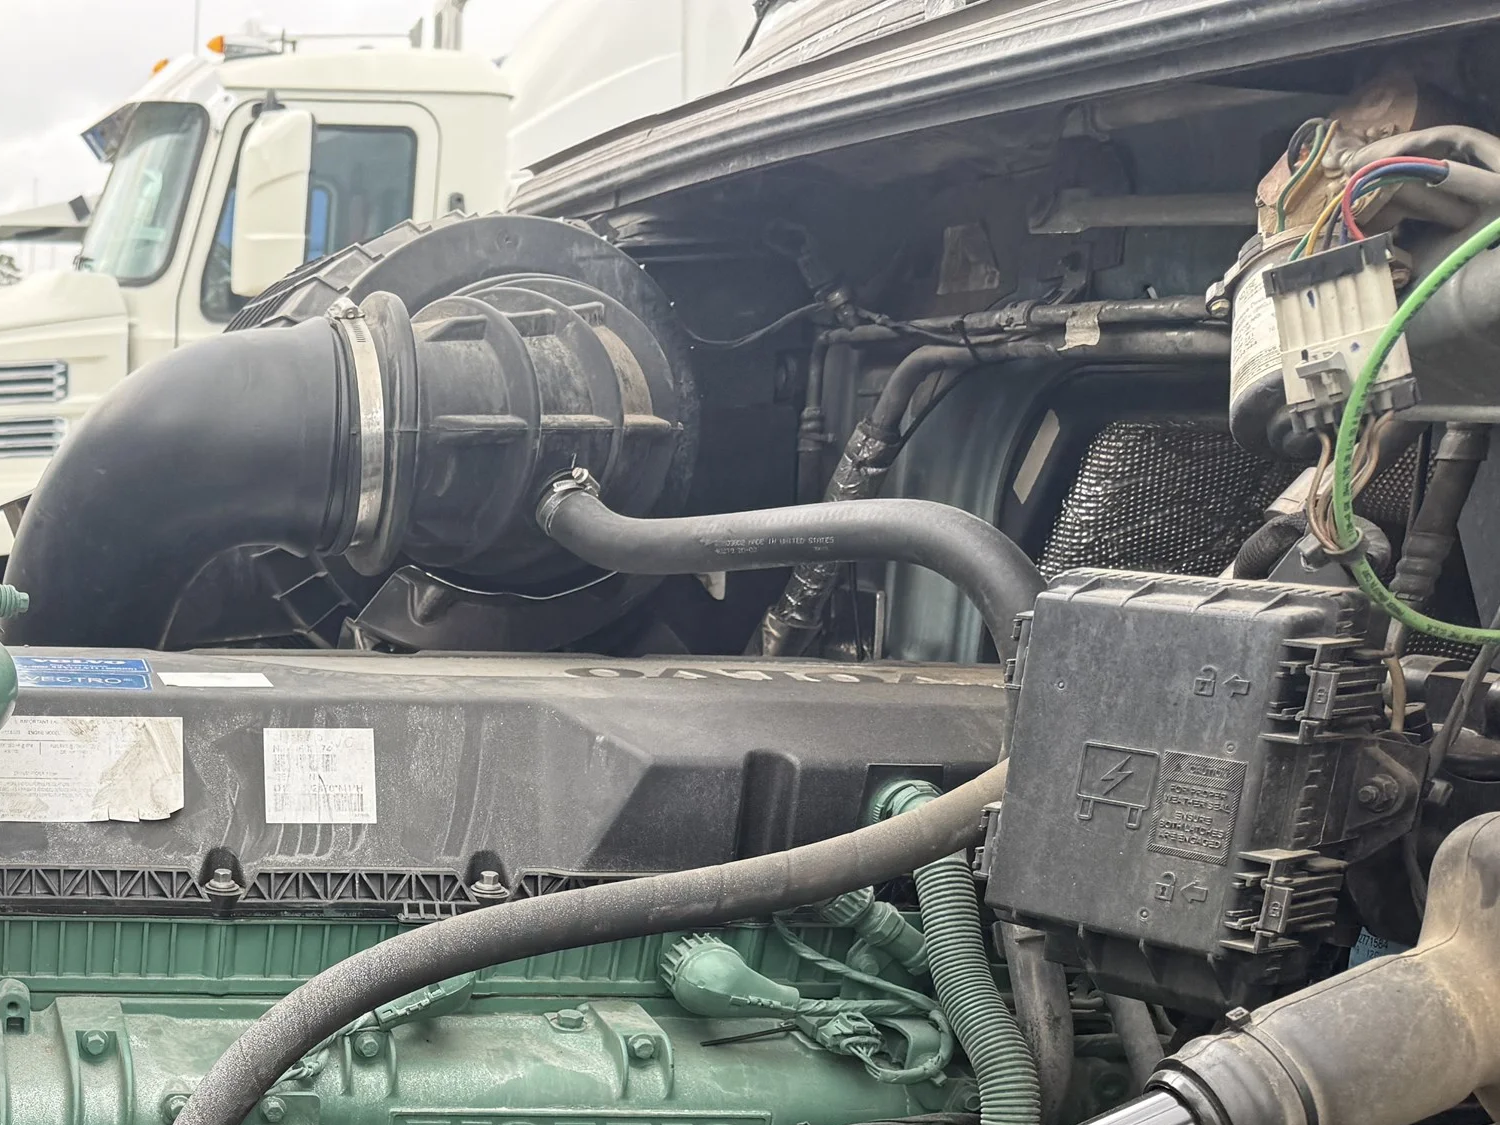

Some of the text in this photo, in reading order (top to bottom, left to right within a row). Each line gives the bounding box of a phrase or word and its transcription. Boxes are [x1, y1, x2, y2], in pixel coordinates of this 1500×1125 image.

[808, 535, 835, 545] STATES
[30, 657, 127, 666] VOLVO
[1170, 783, 1228, 801] FOR PROPER
[1175, 810, 1213, 825] ENSURE
